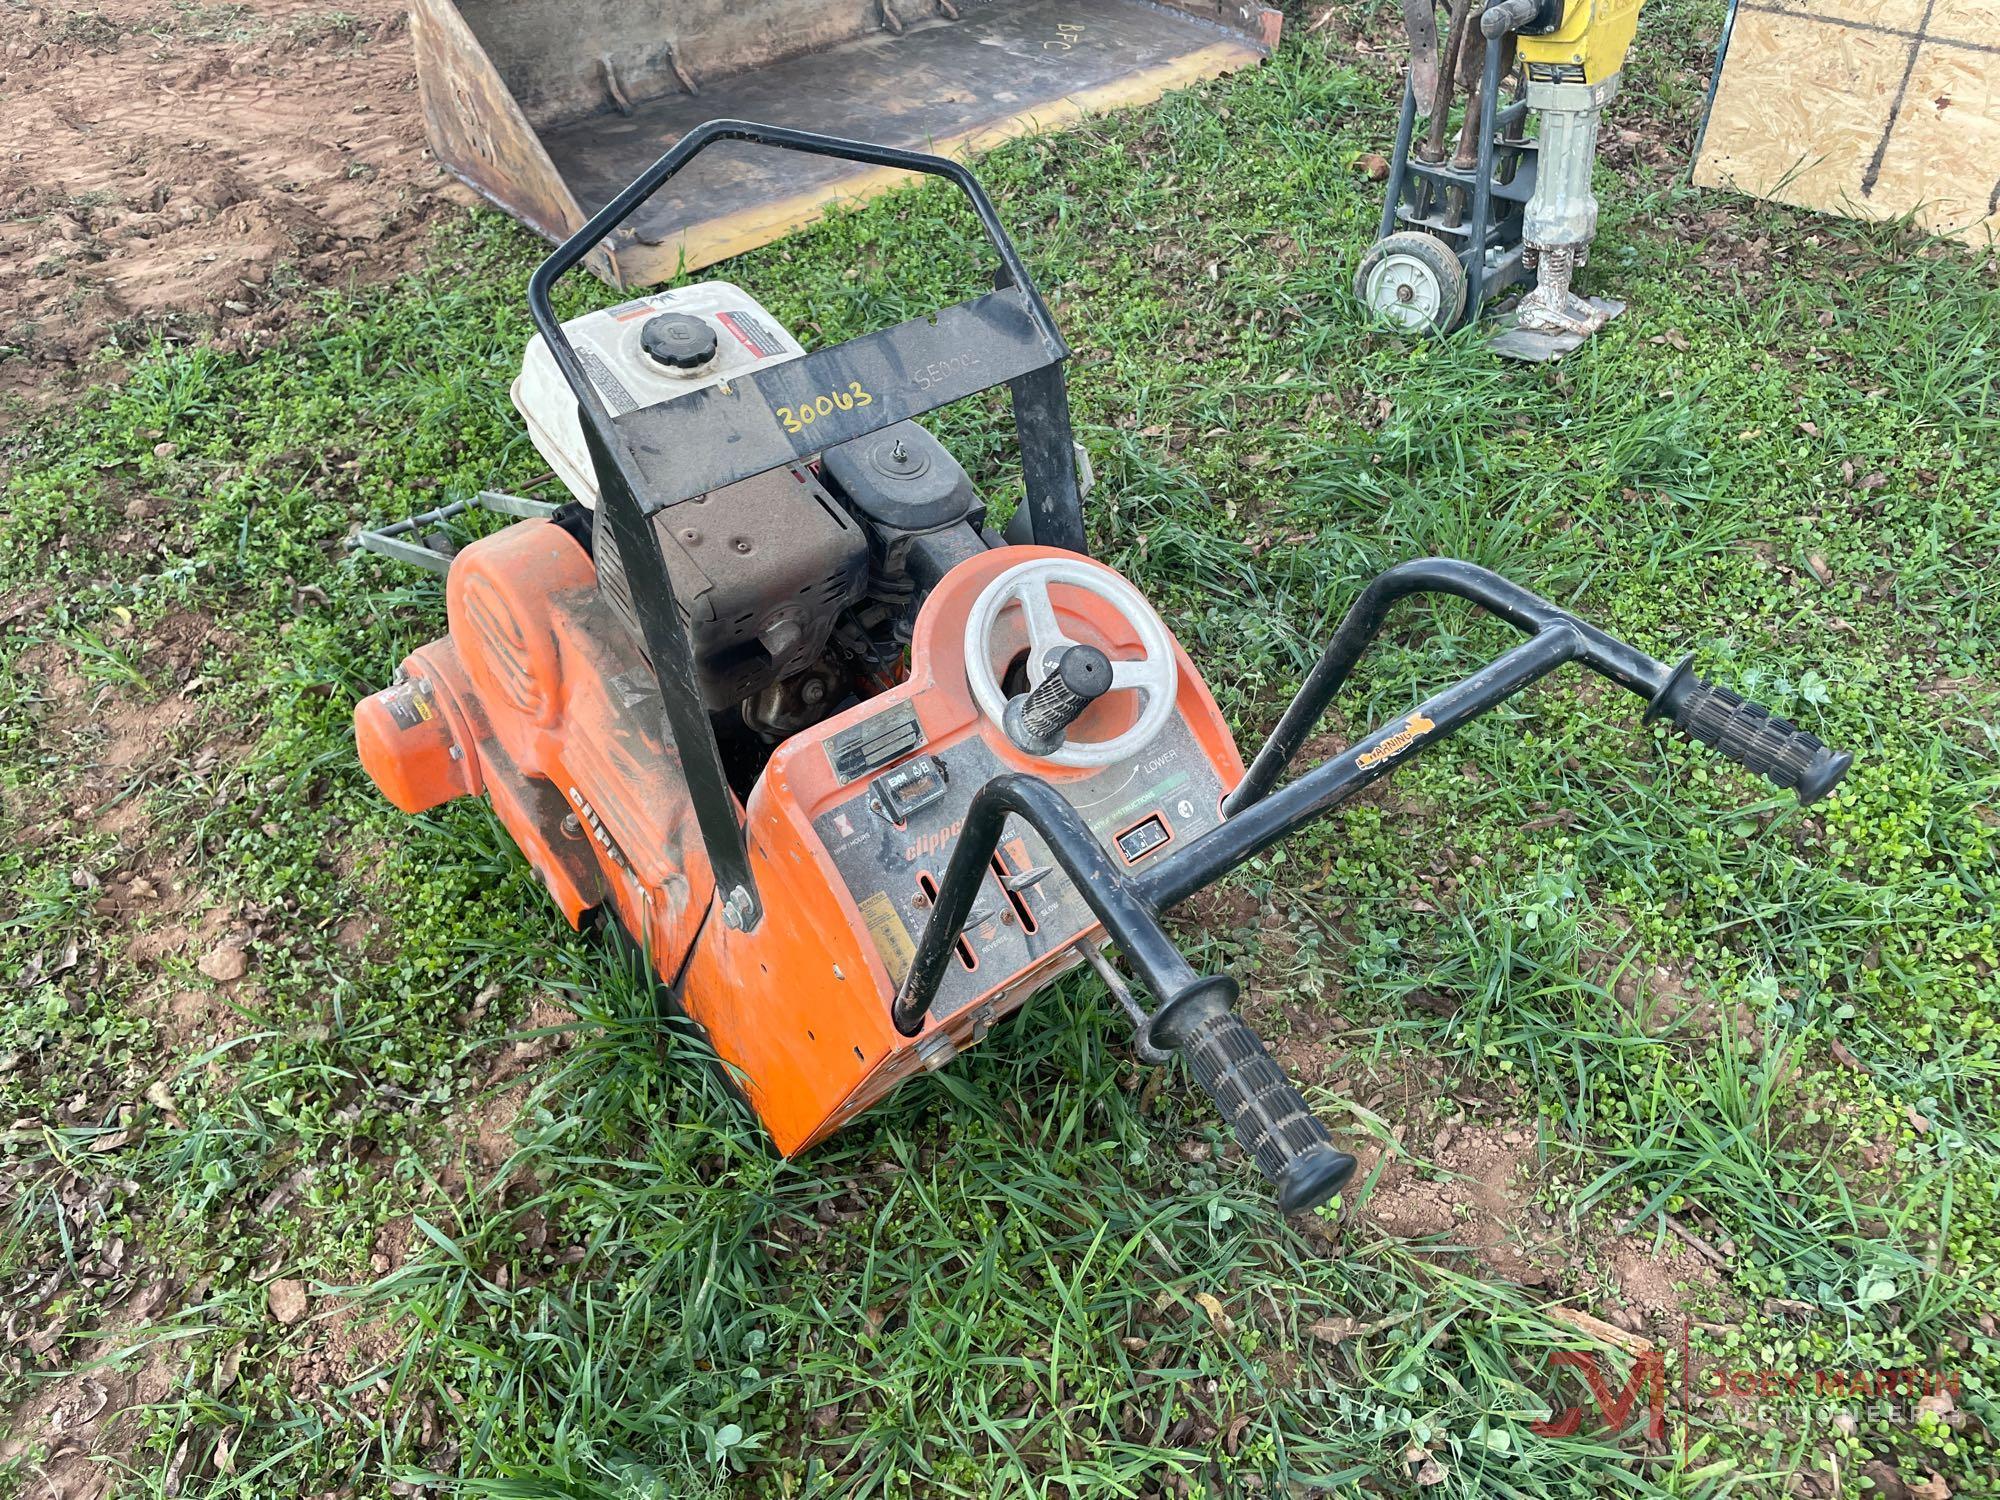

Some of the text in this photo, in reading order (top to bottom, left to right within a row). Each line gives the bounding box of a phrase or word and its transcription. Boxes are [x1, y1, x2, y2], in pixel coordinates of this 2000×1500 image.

[1043, 23, 1086, 50] BFC
[776, 381, 873, 433] 30063
[1143, 749, 1178, 774] LOWER
[849, 832, 871, 847] HOURS
[905, 816, 966, 861] clippe
[1000, 829, 1016, 842] FAST
[1041, 902, 1060, 917] SLOW
